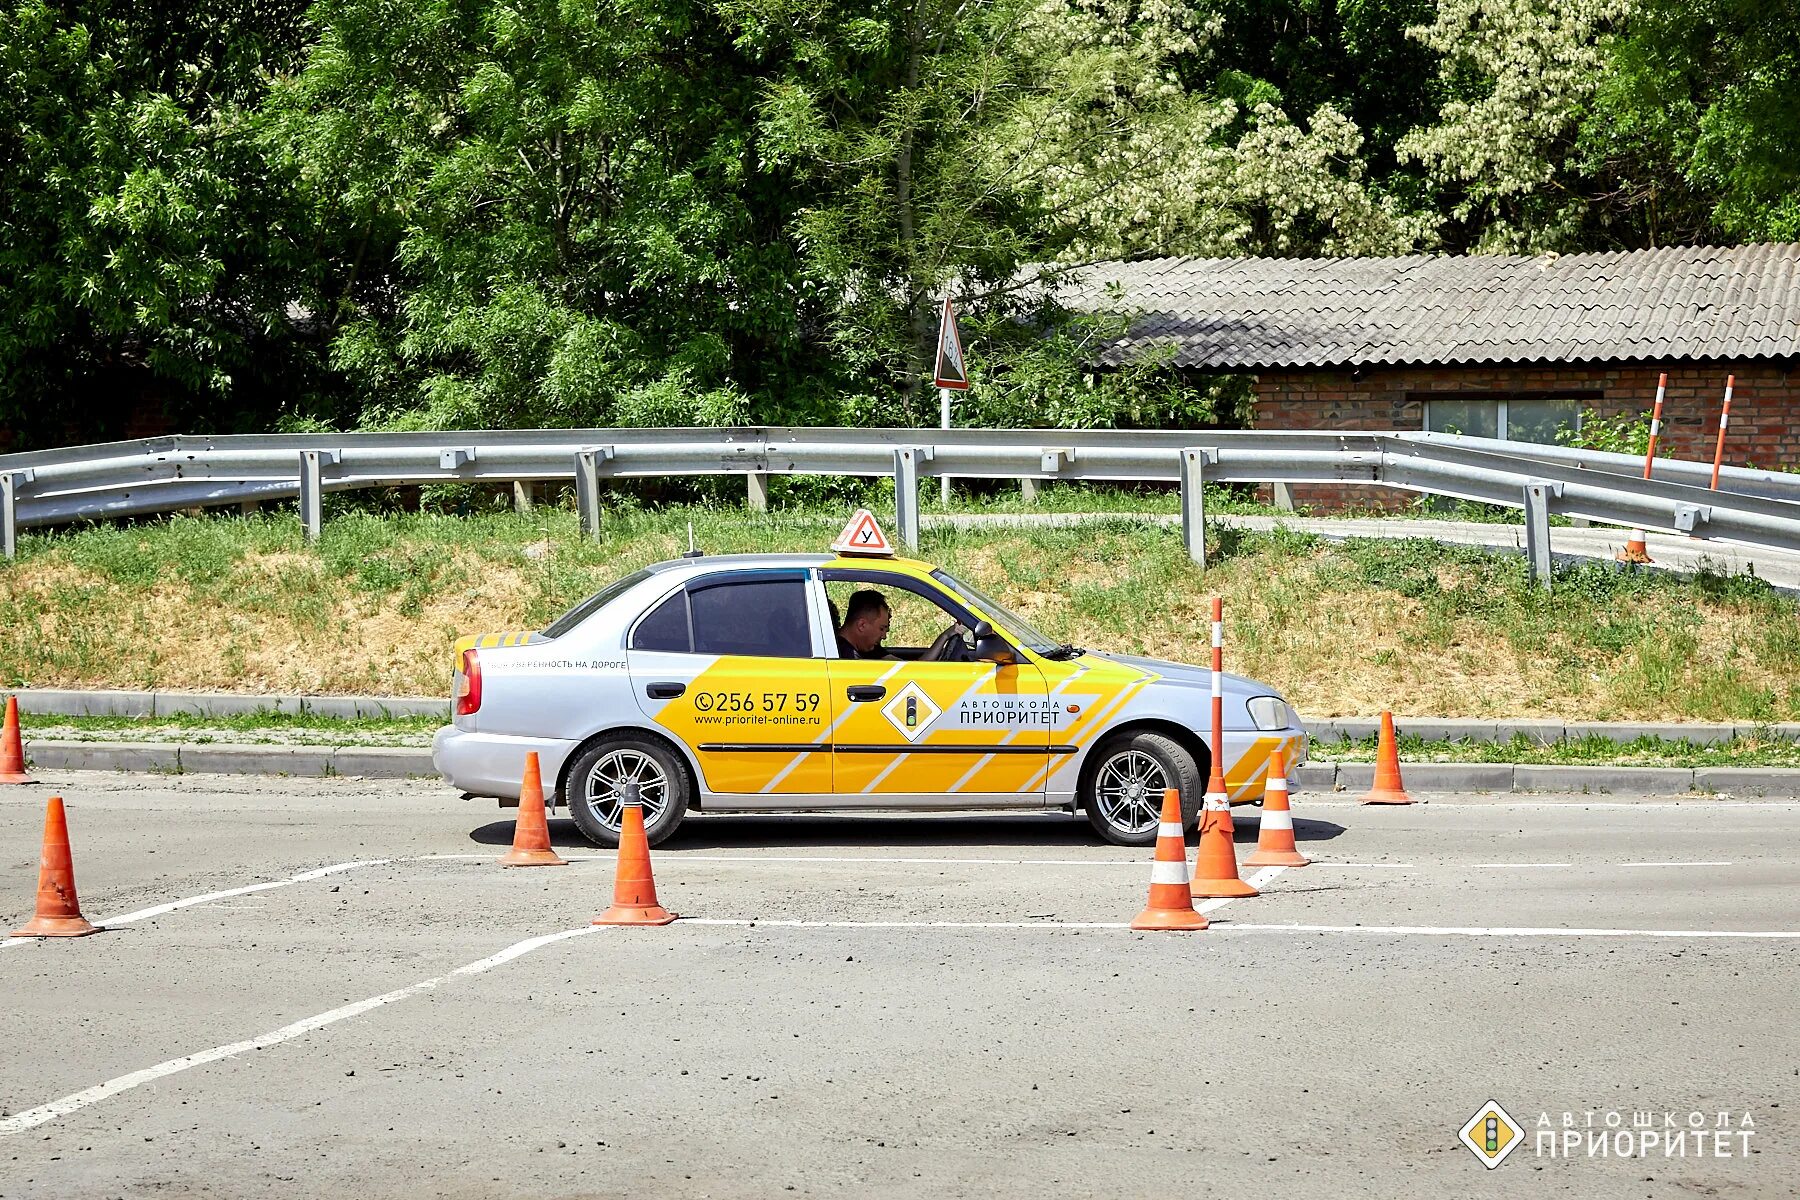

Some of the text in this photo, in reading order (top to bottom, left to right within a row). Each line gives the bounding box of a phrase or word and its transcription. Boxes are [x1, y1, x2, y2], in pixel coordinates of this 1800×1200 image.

[861, 530, 873, 544] У
[575, 660, 588, 668] НА
[590, 660, 626, 669] ДОРОГЕ
[716, 692, 820, 712] 256 57 59
[960, 700, 1060, 709] АВТОШКОЛА
[694, 714, 820, 727] www.prioritet-online.ru
[960, 711, 1060, 724] ПРИОРИТЕТ
